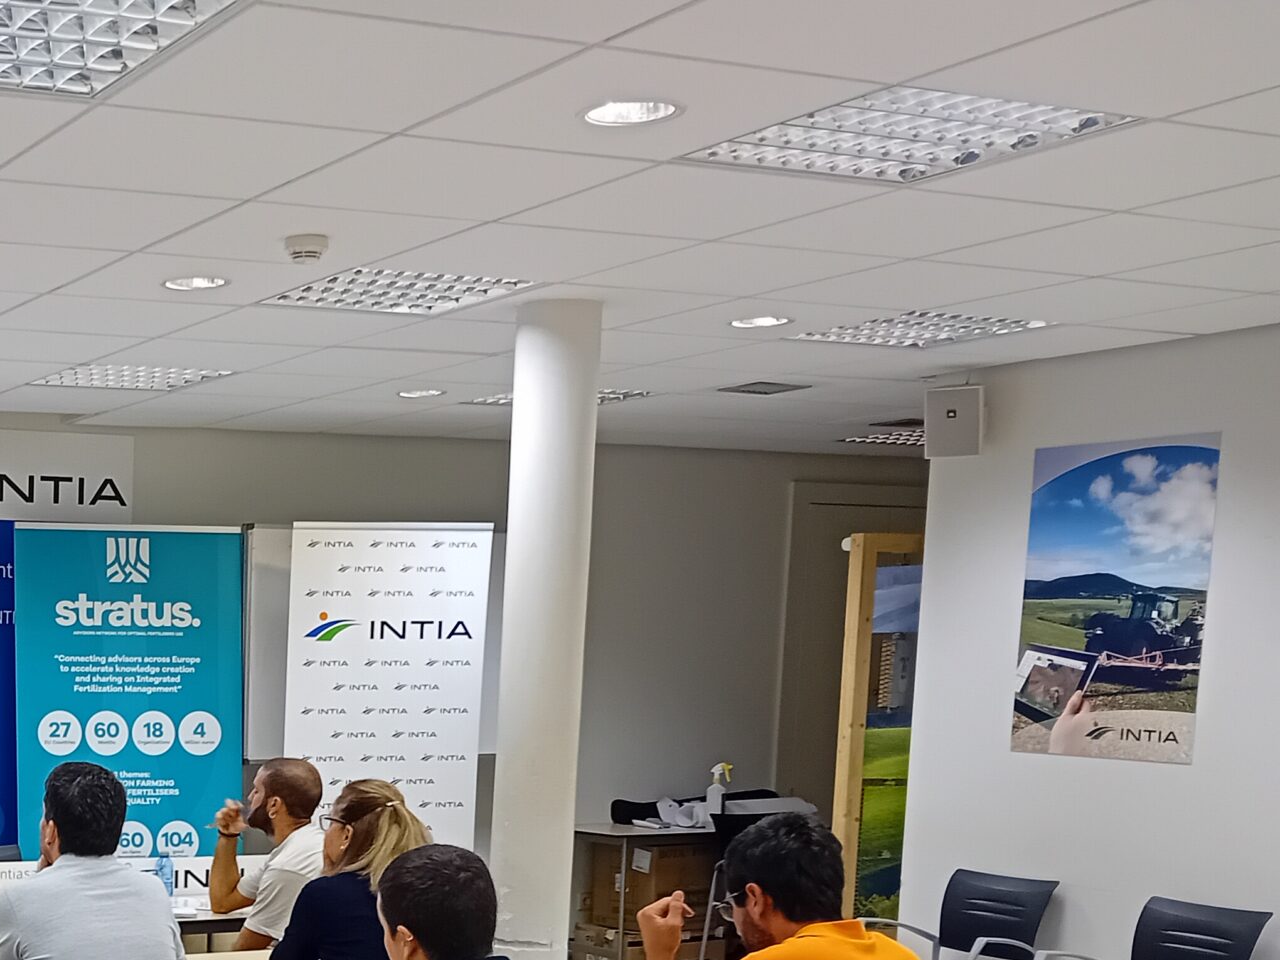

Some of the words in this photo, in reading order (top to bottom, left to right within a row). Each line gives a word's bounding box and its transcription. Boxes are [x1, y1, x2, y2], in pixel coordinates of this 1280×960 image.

[324, 540, 354, 548] INTIA
[448, 541, 478, 549] INTIA
[354, 565, 384, 573] INTIA
[416, 565, 446, 573] INTIA
[55, 593, 201, 628] stratus.
[370, 621, 472, 640] INTIA
[108, 655, 142, 663] advisors
[172, 656, 201, 665] Europe
[441, 659, 472, 667] INTIA
[71, 664, 114, 673] accelerate
[115, 664, 160, 674] knowledge
[162, 665, 195, 673] creation
[75, 674, 90, 682] and
[92, 674, 123, 684] sharing
[136, 675, 181, 684] Integrated
[410, 683, 440, 691] INTIA
[378, 707, 408, 715] INTIA
[49, 722, 71, 738] 27
[94, 722, 120, 738] 60
[143, 722, 164, 738] 18
[193, 722, 206, 738] 4
[346, 731, 377, 739] INTIA
[1120, 728, 1179, 744] INTIA
[136, 779, 175, 787] FARMING
[127, 788, 180, 796] FERTILISERS
[161, 831, 194, 848] 104
